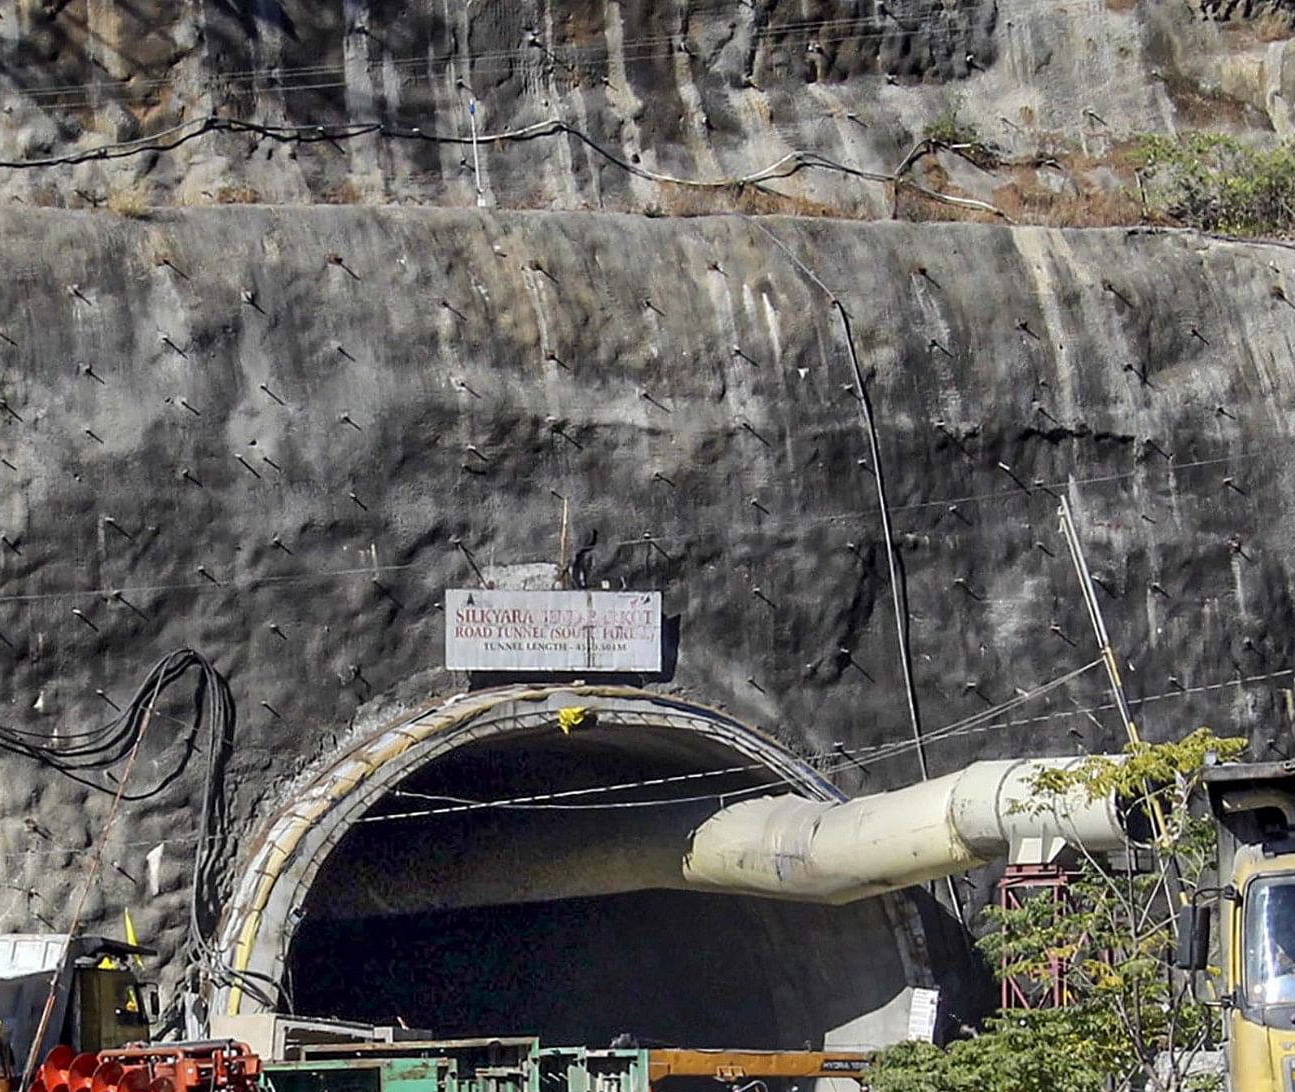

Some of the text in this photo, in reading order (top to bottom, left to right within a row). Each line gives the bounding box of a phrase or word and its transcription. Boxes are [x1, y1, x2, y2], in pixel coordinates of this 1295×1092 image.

[455, 609, 534, 624] SILKYARA
[455, 626, 494, 639] ROAD
[497, 626, 547, 639] TUNNEL
[484, 642, 523, 651] TUNNEL
[526, 642, 568, 652] LENGTH
